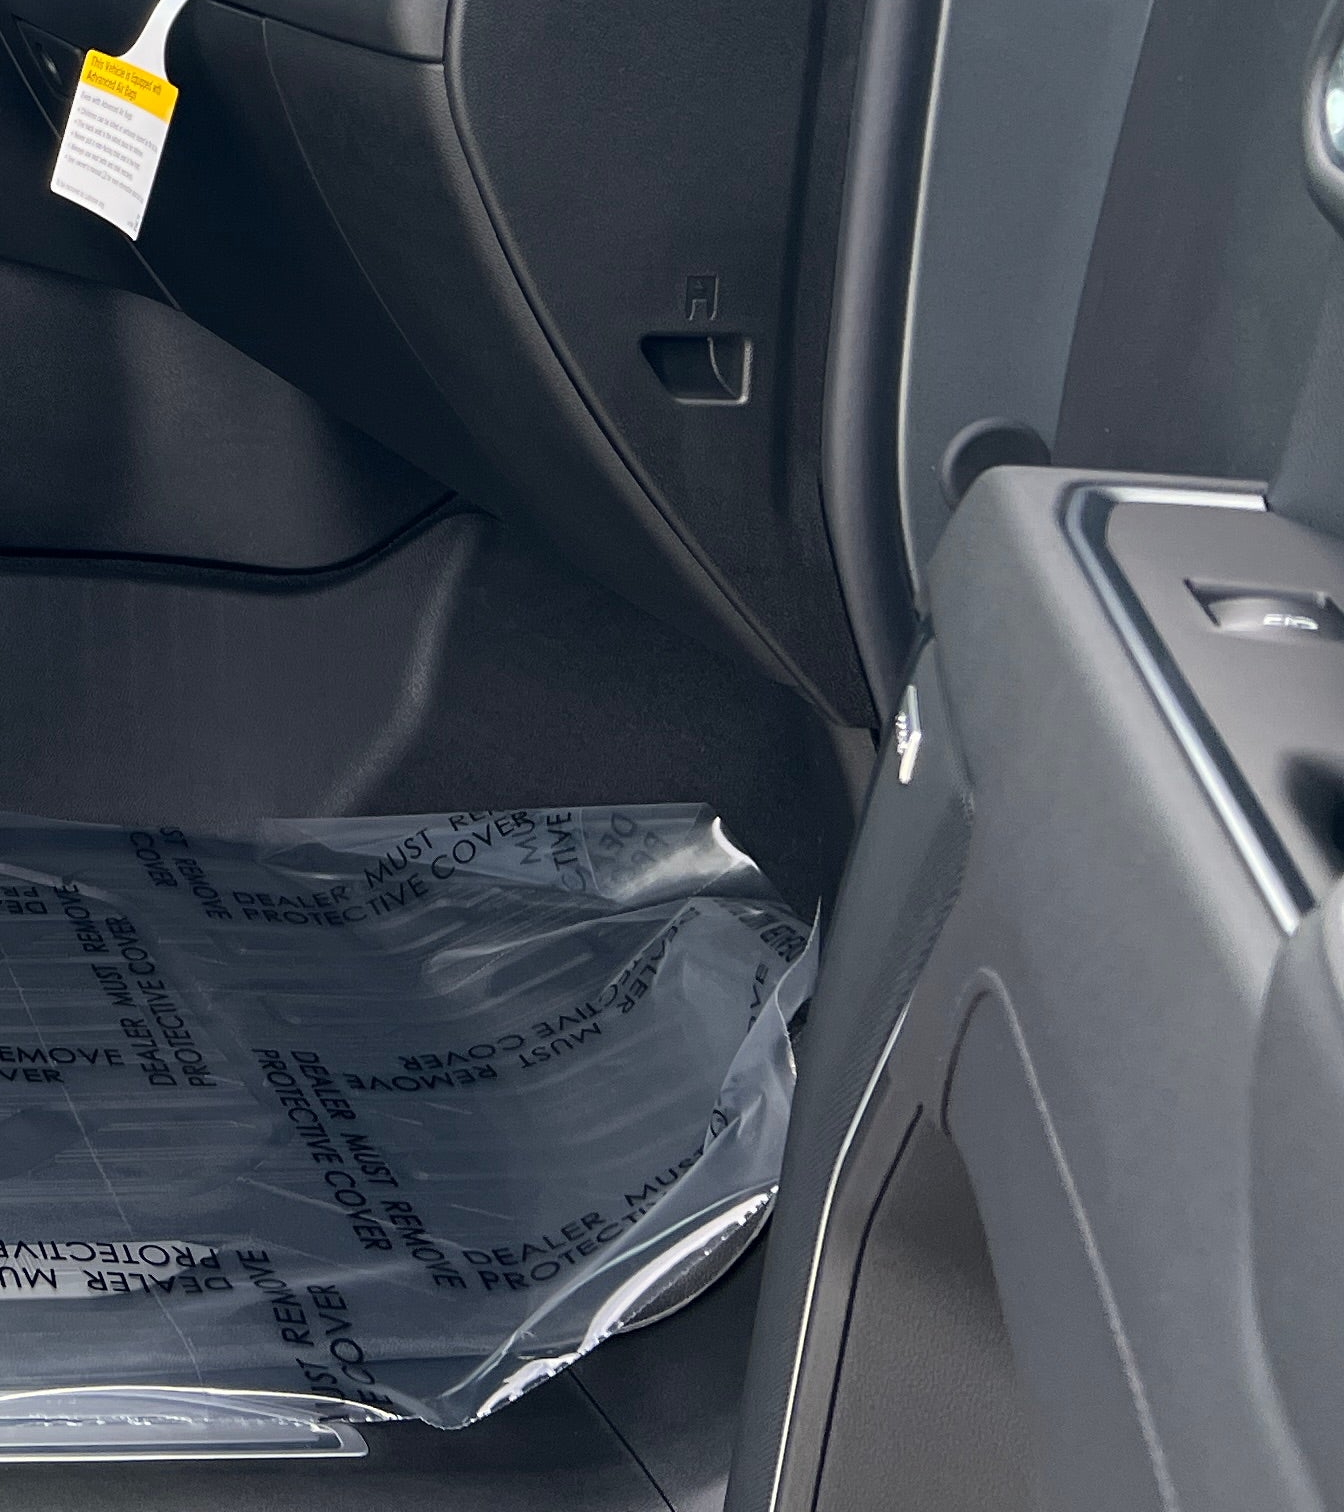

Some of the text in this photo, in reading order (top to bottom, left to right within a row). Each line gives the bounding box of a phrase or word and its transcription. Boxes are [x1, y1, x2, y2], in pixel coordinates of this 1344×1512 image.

[130, 831, 178, 888] COVER
[173, 857, 232, 920] REMOVE
[233, 886, 349, 909] DEALER
[364, 828, 434, 888] MUST
[245, 874, 429, 926] PROTECTIVE
[431, 811, 530, 880] COVER
[53, 884, 177, 1087] DEALER MUST REMOVE
[105, 915, 218, 1087] PROTECTIVE COVER
[343, 1064, 497, 1092] REMOVE
[399, 1034, 525, 1071] COVER
[518, 1022, 603, 1069] MUST
[251, 1048, 393, 1252] PROTECTIVE COVER
[291, 1050, 467, 1289] DEALER MUST REMOVE
[464, 1211, 606, 1267] DEALER
[83, 1268, 233, 1295] DEALER
[236, 1249, 315, 1347] REMOVE
[306, 1284, 375, 1385] COVER
